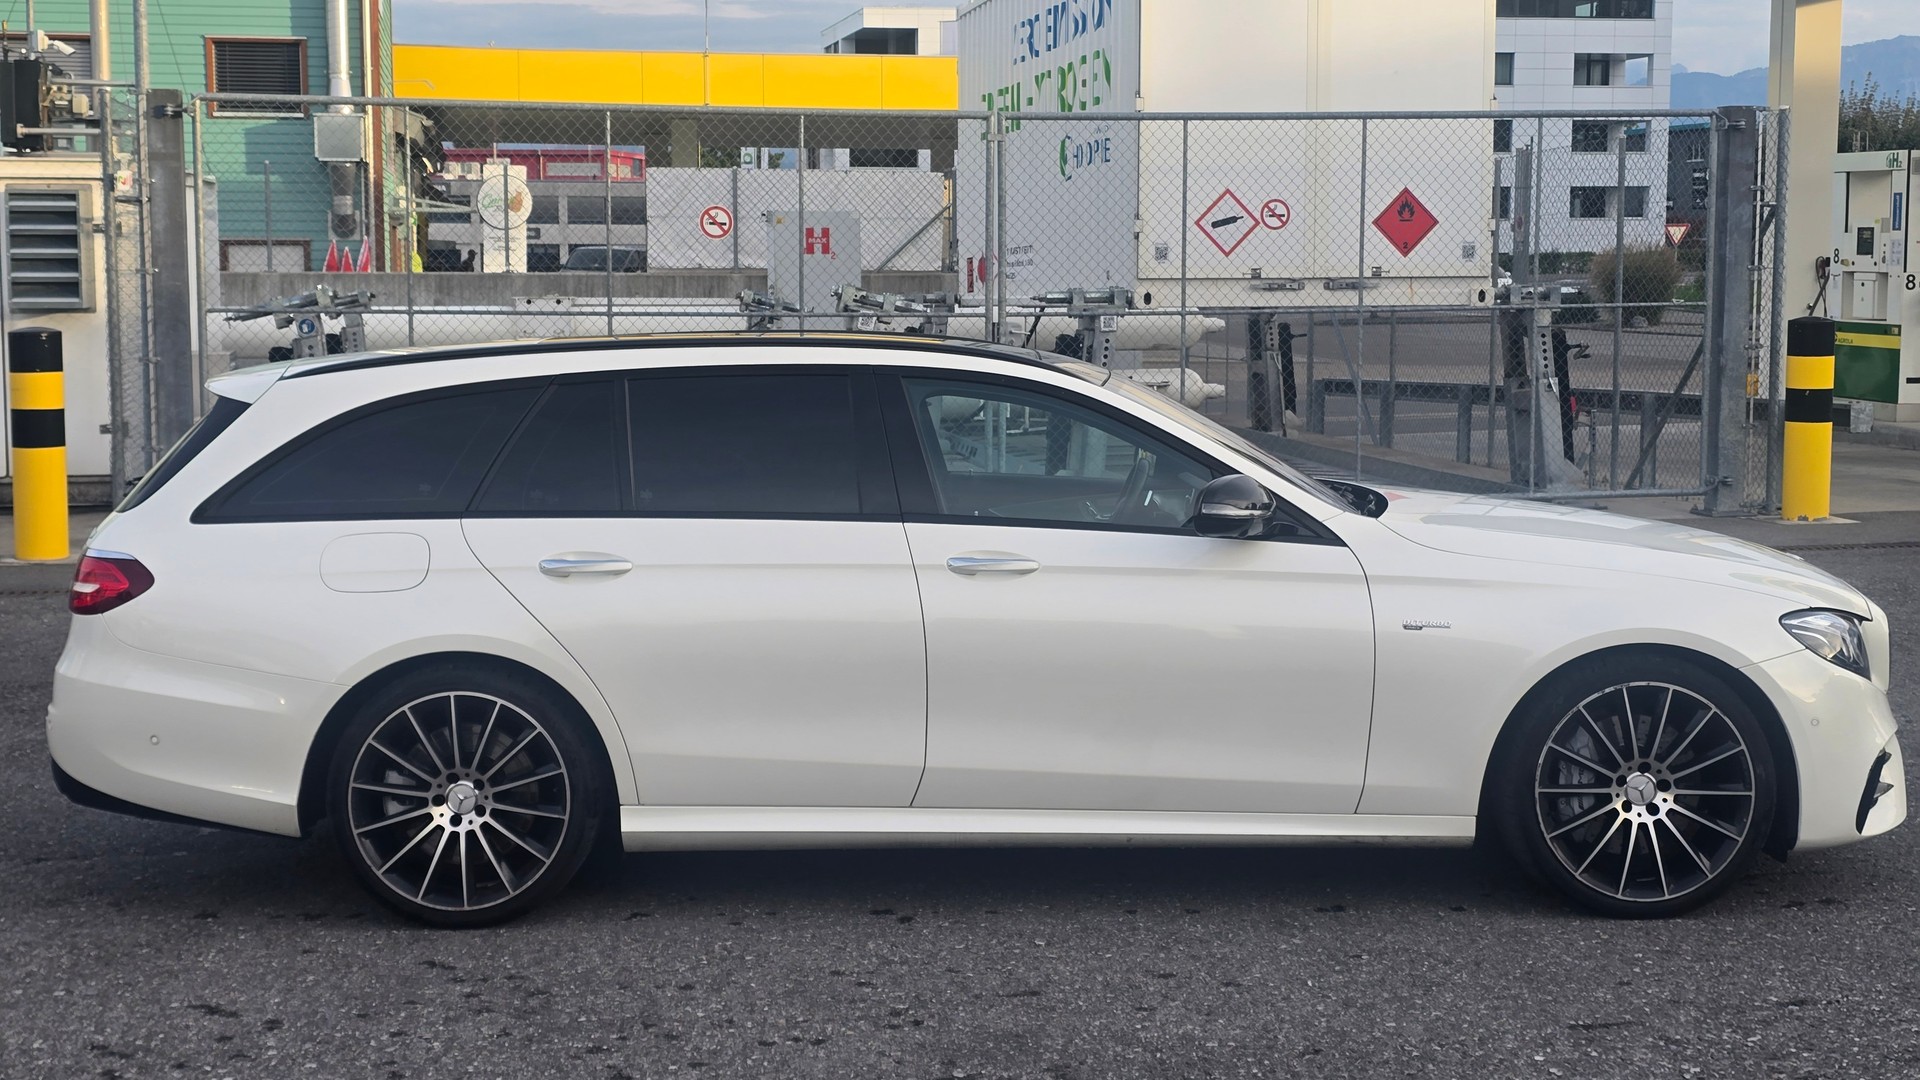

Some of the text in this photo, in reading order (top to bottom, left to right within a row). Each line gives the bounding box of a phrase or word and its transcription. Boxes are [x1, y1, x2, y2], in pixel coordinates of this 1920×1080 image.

[1402, 241, 1409, 249] 2
[1833, 248, 1840, 264] 8
[1905, 274, 1916, 290] 8
